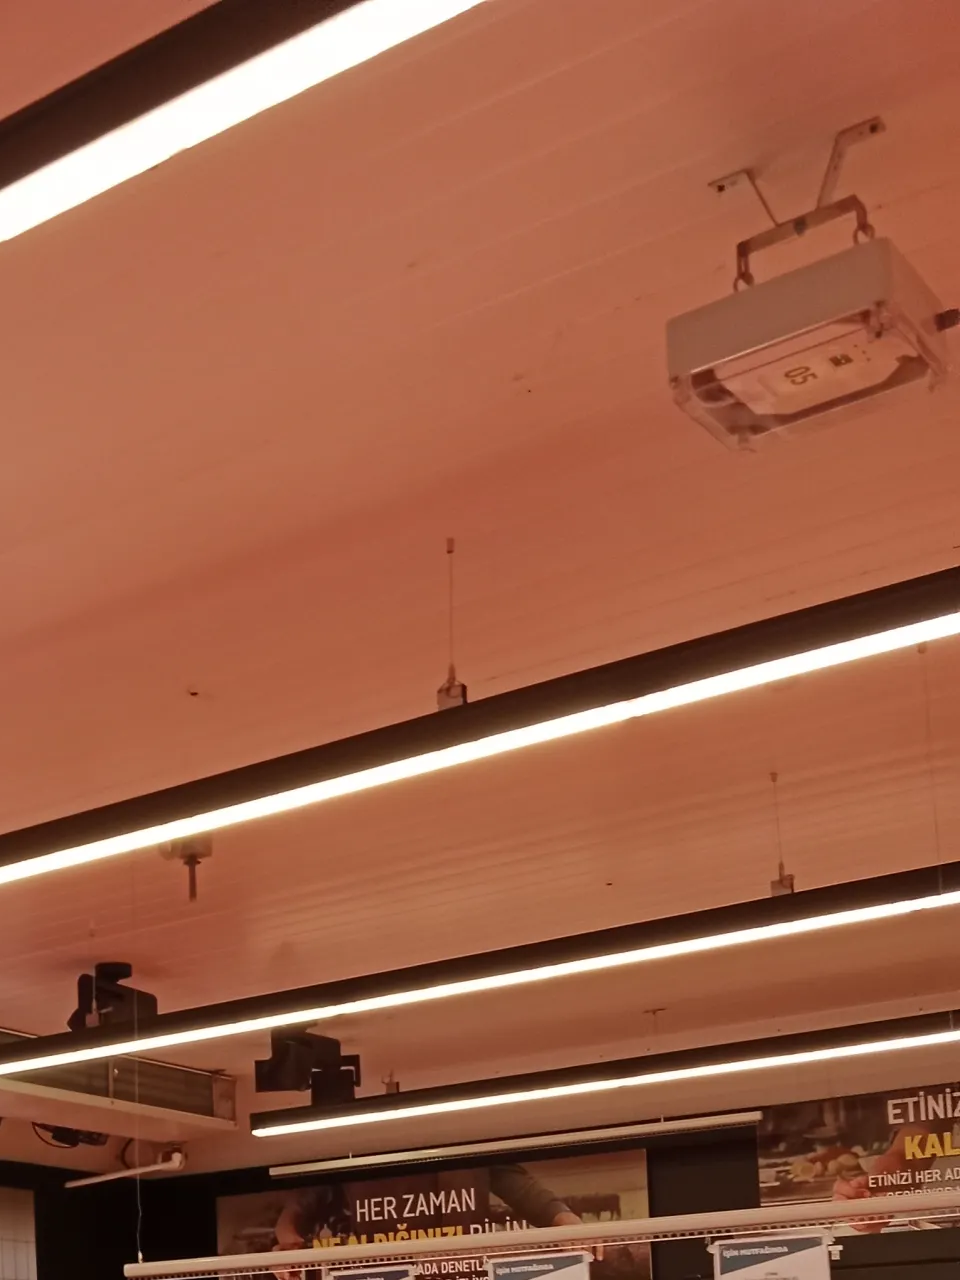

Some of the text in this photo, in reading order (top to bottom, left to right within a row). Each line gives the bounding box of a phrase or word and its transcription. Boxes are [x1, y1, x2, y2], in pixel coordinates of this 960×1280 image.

[904, 1132, 960, 1160] KAL
[868, 1169, 912, 1188] ETİNİZİ
[915, 1169, 942, 1183] HER
[356, 1188, 476, 1223] HER ZAMAN
